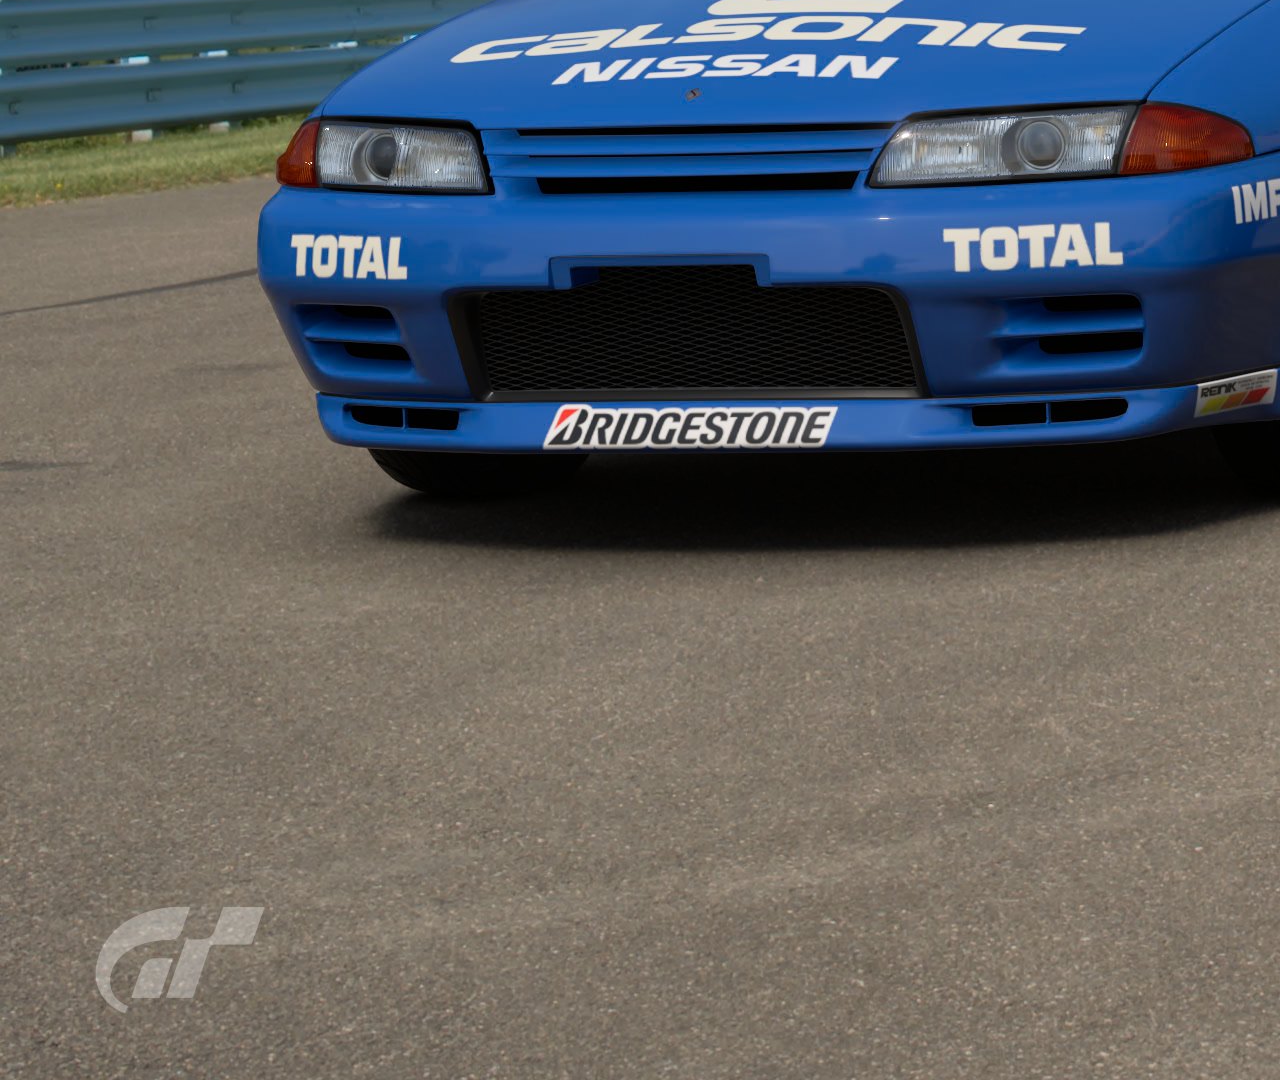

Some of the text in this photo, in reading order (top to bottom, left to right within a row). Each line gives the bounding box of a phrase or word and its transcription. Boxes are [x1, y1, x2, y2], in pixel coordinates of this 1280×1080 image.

[551, 54, 899, 86] NISSAN
[290, 233, 408, 280] TOTAL
[942, 222, 1124, 273] TOTAL
[547, 406, 829, 448] BRIDGESTONE
